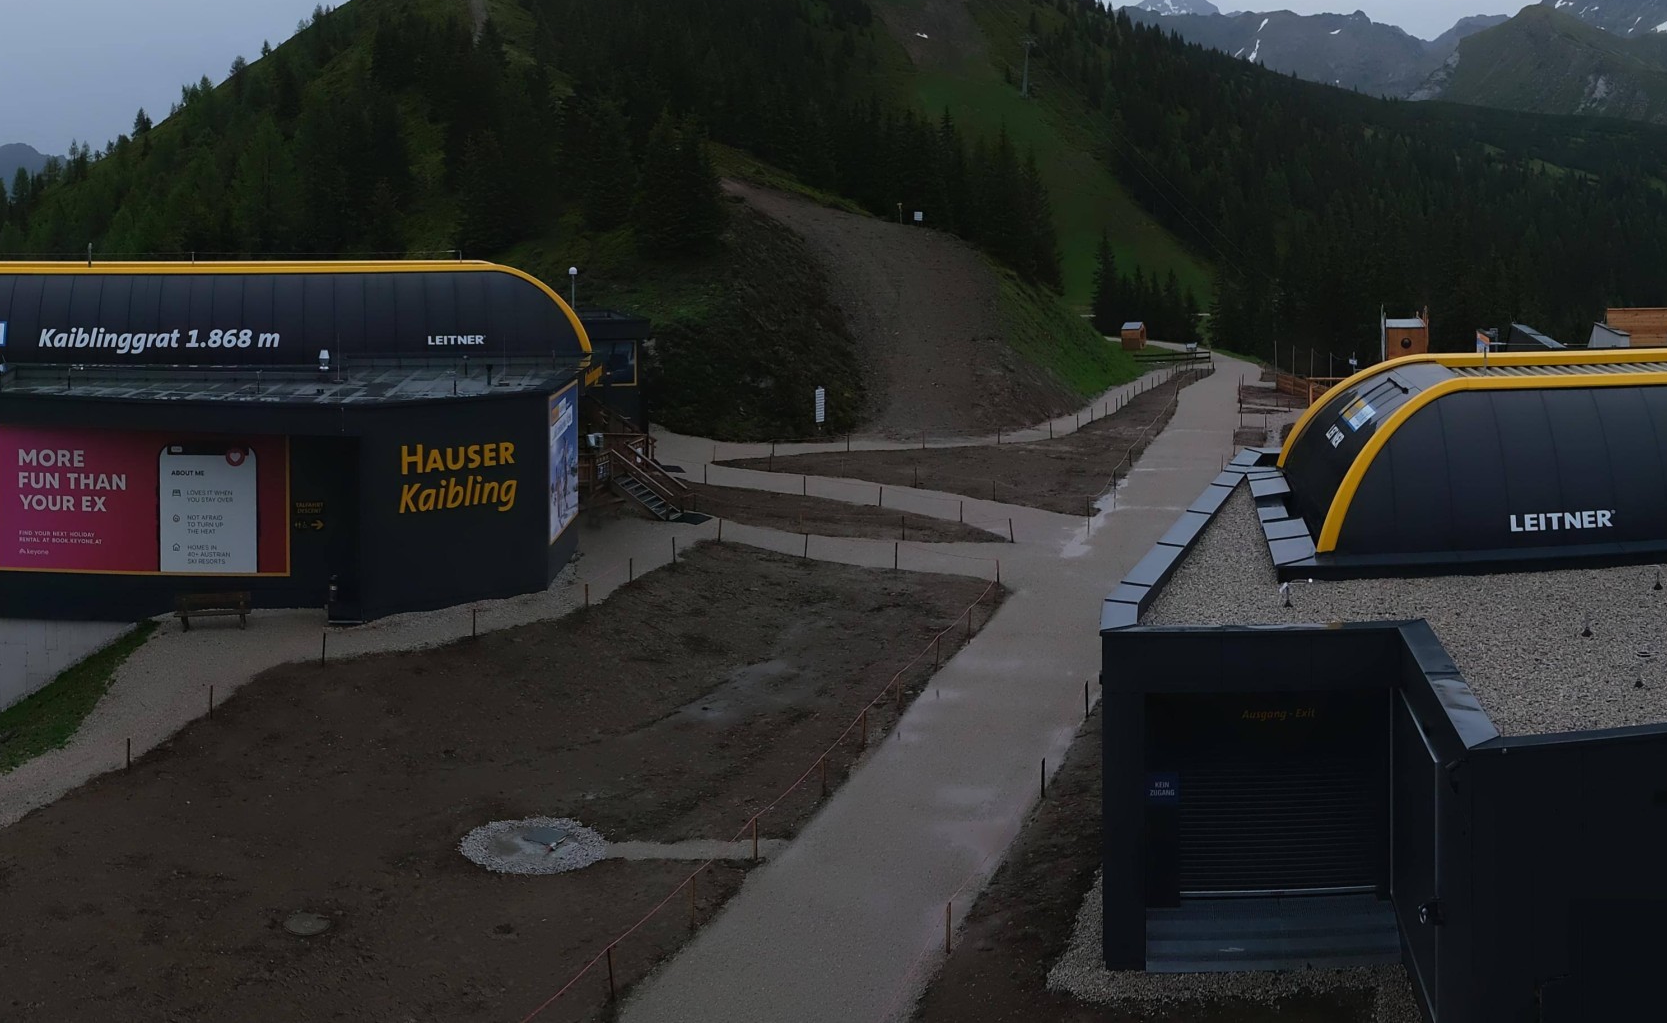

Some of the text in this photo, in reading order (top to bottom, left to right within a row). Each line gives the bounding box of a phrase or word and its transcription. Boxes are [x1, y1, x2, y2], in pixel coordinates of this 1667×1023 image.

[38, 328, 280, 354] Kaiblinggrat 1.868 m
[427, 335, 485, 345] LEITNER
[18, 449, 85, 468] MORE
[18, 472, 126, 491] FUN THAN
[20, 494, 107, 512] YOUR EX
[398, 475, 518, 514] Kaibling
[1510, 510, 1613, 532] LEITNER
[1241, 710, 1288, 721] Ausgang
